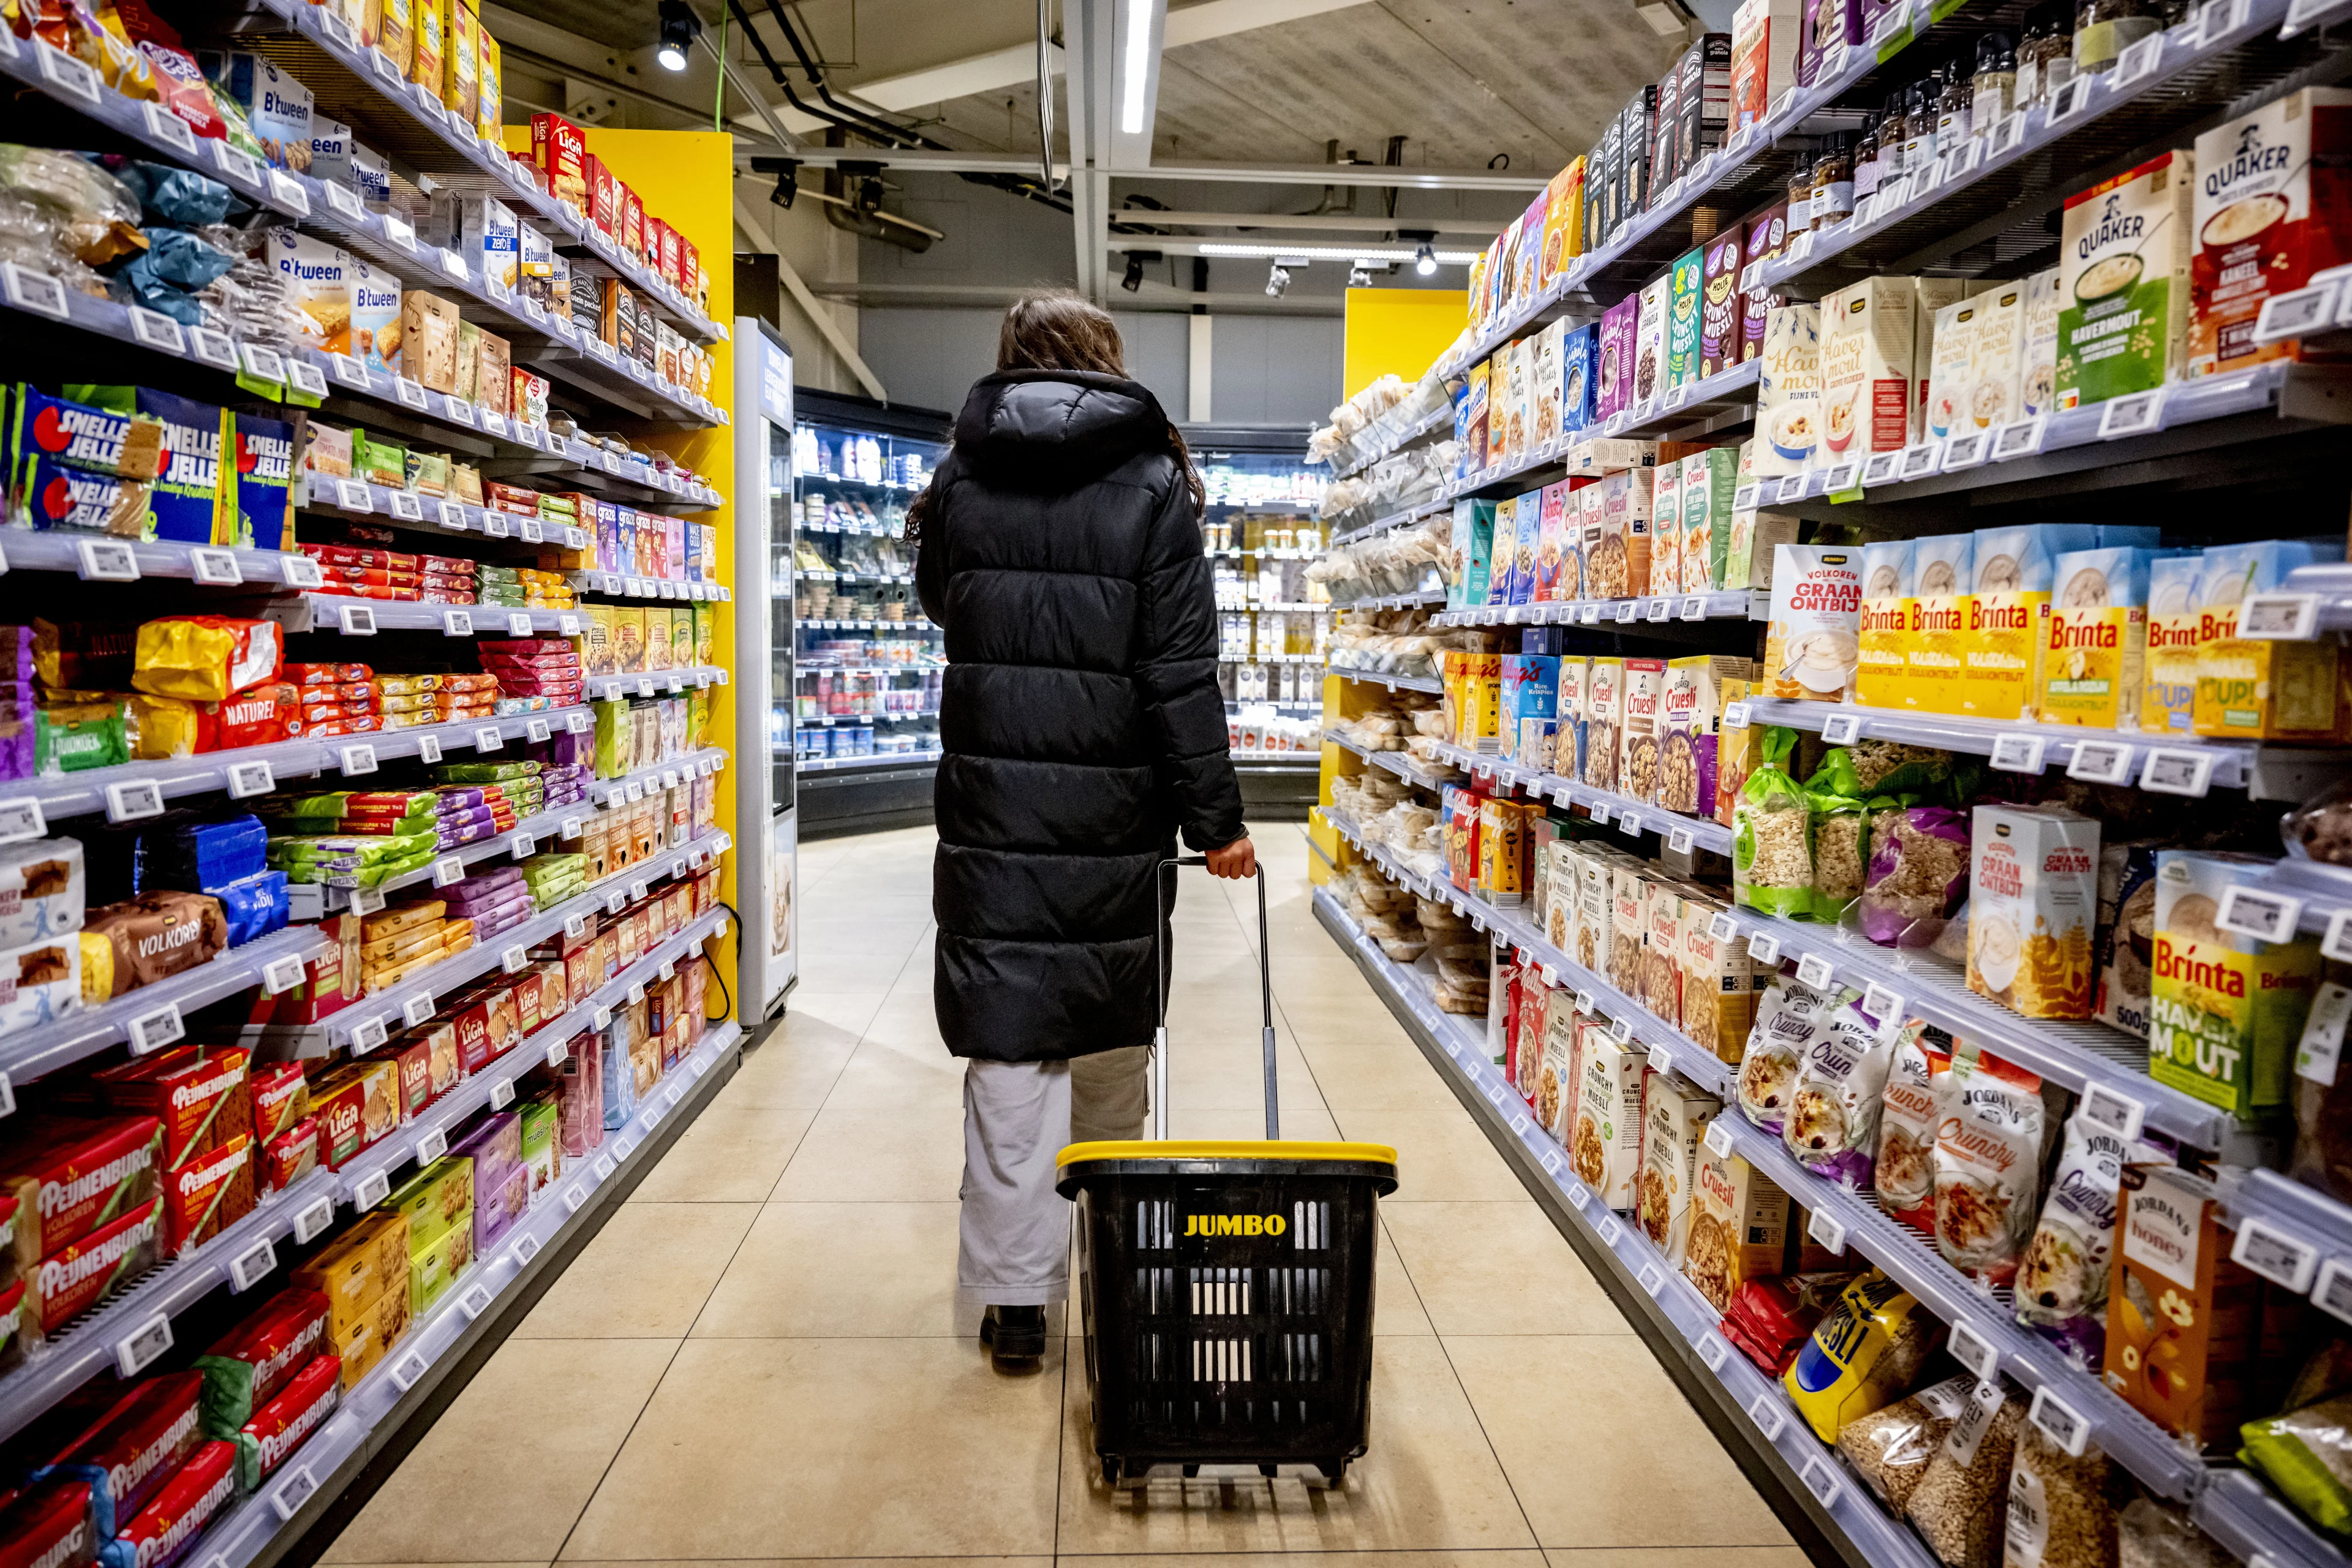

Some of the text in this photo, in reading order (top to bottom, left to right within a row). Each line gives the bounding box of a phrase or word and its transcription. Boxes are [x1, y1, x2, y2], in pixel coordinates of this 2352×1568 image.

[422, 11, 443, 47] belvita
[1740, 17, 1757, 38] Bolletje
[1741, 25, 1763, 58] SMAAK!
[456, 39, 477, 72] belvita
[482, 62, 500, 97] belvita
[1681, 66, 1701, 92] granola
[265, 92, 307, 120] B'tween
[559, 132, 582, 157] LiGA
[2206, 145, 2291, 195] QUAKER
[489, 219, 514, 237] B'tween
[2079, 216, 2144, 258] QUAKER
[492, 238, 507, 249] zero
[525, 248, 550, 263] B'tween
[281, 258, 341, 281] B'tween
[358, 287, 396, 306] B'tween
[1713, 281, 1728, 292] HOLIE
[1704, 288, 1736, 320] CRUNCHY
[1642, 313, 1658, 330] GRANOLA
[1673, 304, 1698, 336] CRUNCHY
[1705, 312, 1734, 337] MUESLI
[1744, 317, 1765, 327] CHOCOLATE
[1976, 319, 2016, 340] Haver
[2071, 309, 2142, 345] HAVERMOUT
[1600, 323, 1623, 348] Granola
[1672, 331, 1695, 353] MUESLI
[1821, 331, 1866, 362] Haver
[1934, 334, 1973, 355] Haver
[1981, 335, 2011, 352] mout
[1565, 345, 1588, 368] Granola
[1939, 349, 1967, 366] mout
[1828, 360, 1861, 380] mout
[527, 396, 543, 412] Melba
[1790, 391, 1809, 400] FIJNE
[58, 410, 130, 442] SNELLE
[67, 438, 124, 464] JELLE
[161, 423, 221, 457] SNELLE
[246, 434, 292, 459] SNELLE
[167, 453, 219, 486] JELLE
[255, 455, 292, 478] JELLE
[581, 502, 596, 516] graze
[598, 508, 616, 521] graze
[1583, 506, 1602, 527] Cruesli
[1605, 496, 1626, 518] Cruesli
[619, 513, 635, 526] graze
[636, 516, 650, 529] graze
[652, 519, 666, 532] graze
[690, 525, 700, 536] MADE
[690, 535, 700, 548] GOOD
[1807, 570, 1857, 581] VOLKOREN
[1796, 582, 1862, 598] GRAAN
[592, 627, 605, 635] Protein
[1466, 654, 1501, 685] Kellogg's
[1501, 655, 1544, 690] Kellogg's
[1561, 680, 1579, 699] Cruesli
[1593, 684, 1612, 702] Cruesli
[1666, 687, 1697, 709] Cruesli
[225, 700, 274, 725] NATUREL
[1628, 695, 1656, 715] Cruesli
[1480, 803, 1518, 839] Kellogg's
[1556, 862, 1573, 878] CRUNCHY
[1981, 856, 2021, 881] GRAAN
[1556, 884, 1570, 895] MUESLI
[1583, 878, 1601, 895] CRUNCHY
[1979, 873, 2024, 900] ONTBIJT
[1585, 900, 1599, 914] MUESLI
[1616, 895, 1637, 920] Cruesli
[636, 920, 647, 937] LiGA
[1652, 910, 1676, 939] Cruesli
[603, 938, 616, 957] LiGA
[1687, 930, 1713, 961] Cruesli
[521, 990, 538, 1011] LiGA
[462, 1020, 484, 1044] LiGA
[1551, 1022, 1569, 1042] CRUNCHY
[467, 1041, 483, 1052] EVERGREEN
[1551, 1042, 1566, 1058] MUESLI
[405, 1059, 426, 1086] LiGA
[1588, 1065, 1613, 1091] CRUNCHY
[409, 1079, 425, 1096] EVERGREEN
[178, 1100, 211, 1121] NATUREL
[1588, 1090, 1608, 1111] MUESLI
[1962, 1090, 2019, 1123] JORDANS
[330, 1104, 359, 1138] LiGA
[1653, 1114, 1677, 1142] CRUNCHY
[333, 1129, 358, 1147] EVERGREEN
[527, 1121, 549, 1149] muesli+
[1938, 1117, 2016, 1172] Crunchy
[1654, 1137, 1673, 1163] MUESLI
[185, 1184, 217, 1205] NATUREL
[1702, 1165, 1735, 1208] Cruesli
[2060, 1170, 2116, 1230] Crunchy
[1184, 1215, 1286, 1236] JUMBO
[2134, 1196, 2190, 1236] JORDANS
[2132, 1219, 2186, 1264] honey
